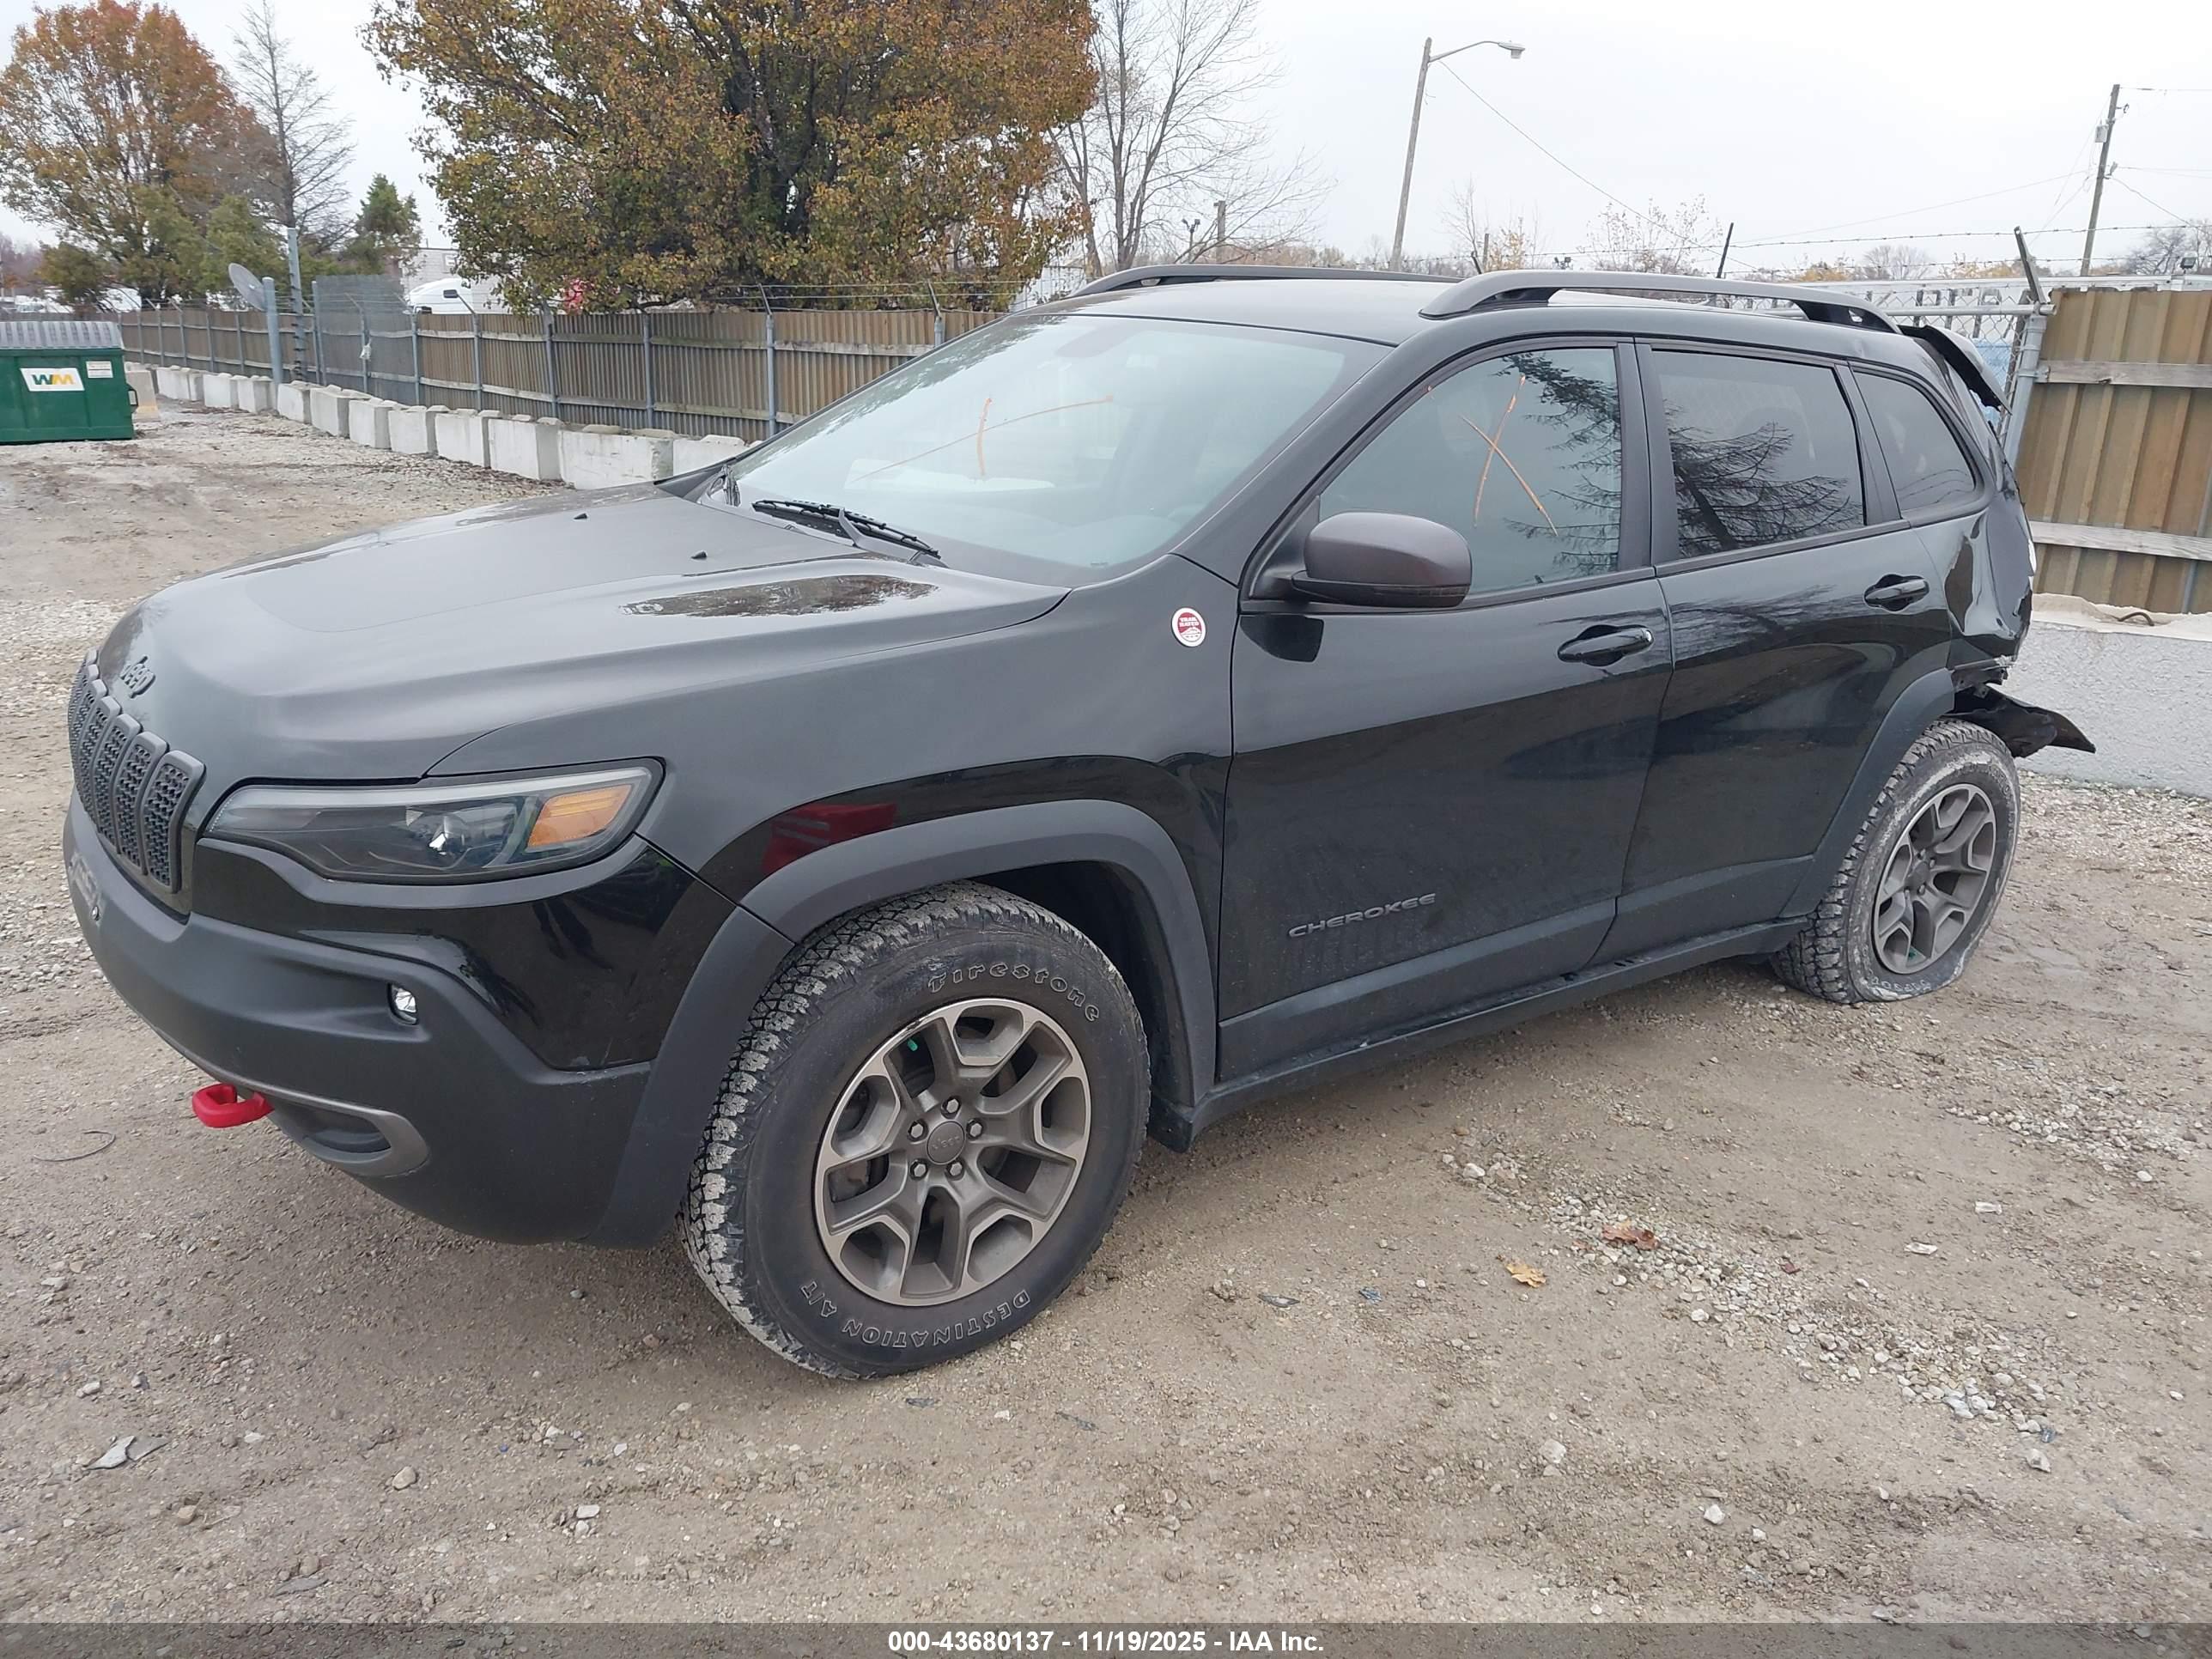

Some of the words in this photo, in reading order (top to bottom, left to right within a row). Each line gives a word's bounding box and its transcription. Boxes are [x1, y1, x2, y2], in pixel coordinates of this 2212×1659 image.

[31, 374, 74, 386] WM
[120, 655, 156, 699] Jeep
[1288, 892, 1437, 938] CHEROKEE
[927, 962, 1100, 1022] Firestone
[842, 1290, 1031, 1348] DESTINATION
